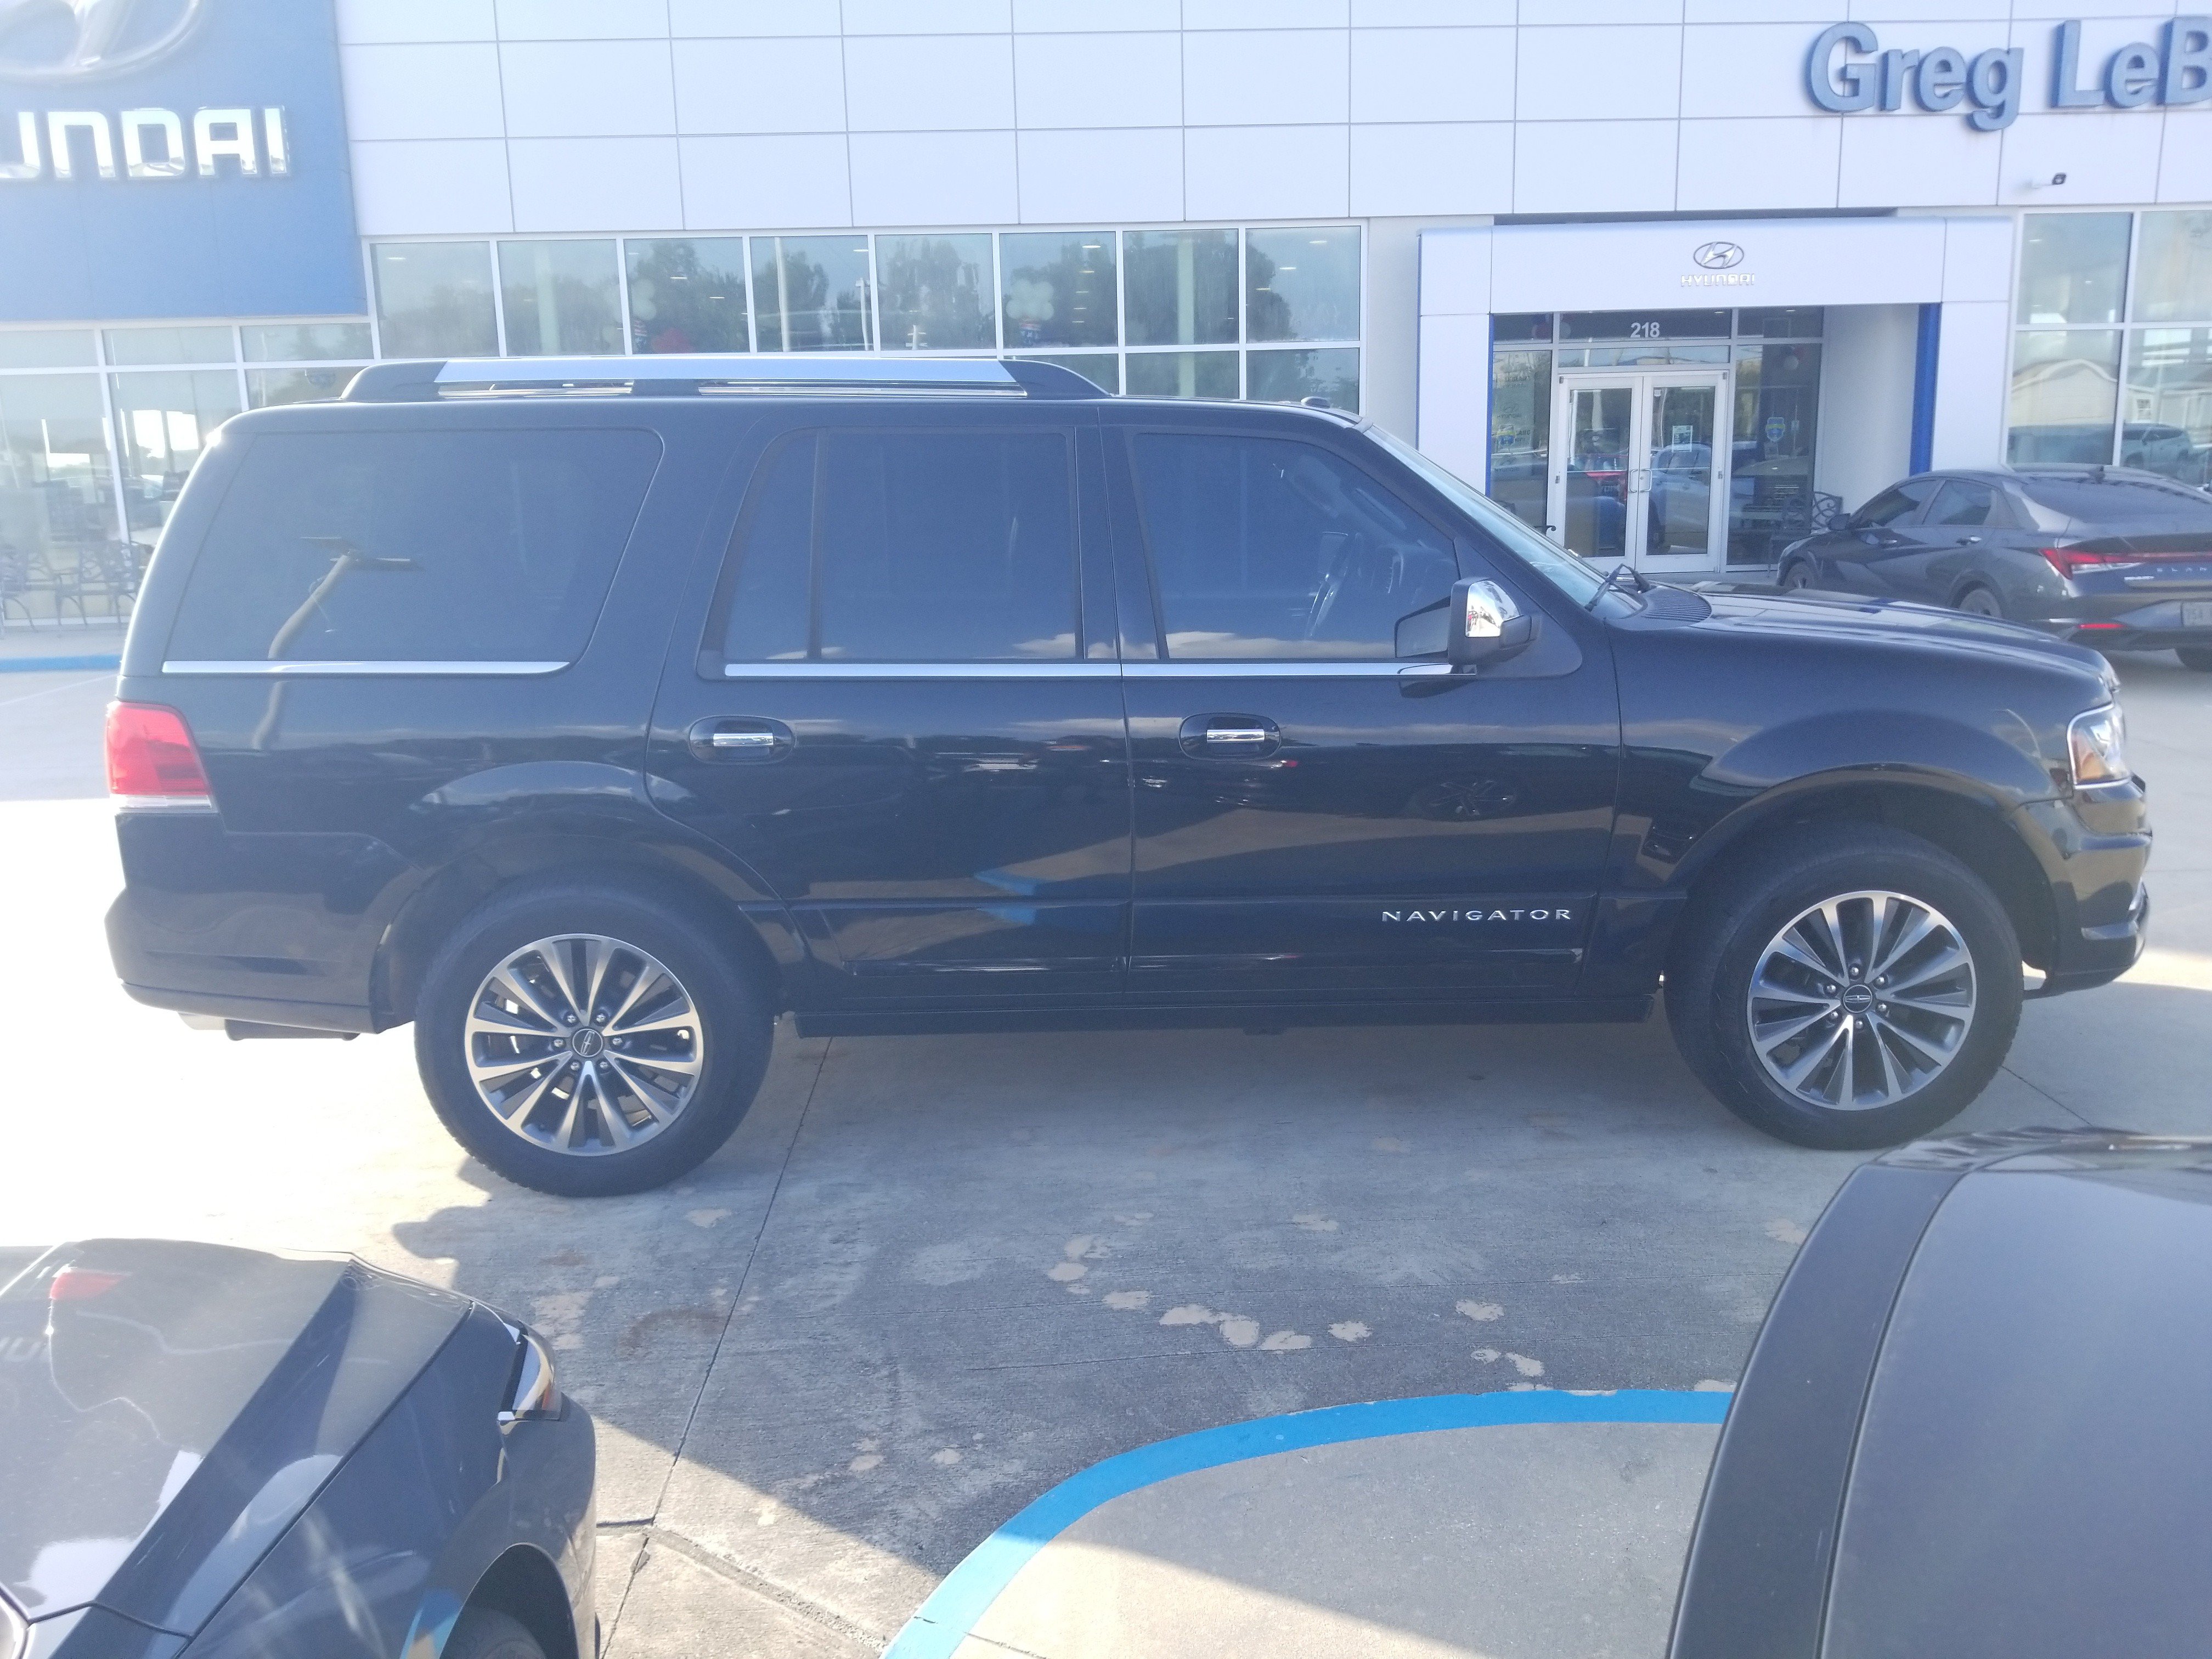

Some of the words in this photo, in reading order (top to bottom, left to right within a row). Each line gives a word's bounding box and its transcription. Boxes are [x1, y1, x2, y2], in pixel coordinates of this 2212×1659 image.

[1805, 21, 2024, 131] Greg
[2050, 16, 2212, 109] LeB
[1680, 273, 1755, 287] HYUNDAI
[1630, 322, 1660, 338] 218
[1381, 909, 1571, 922] NAVIGATOR
